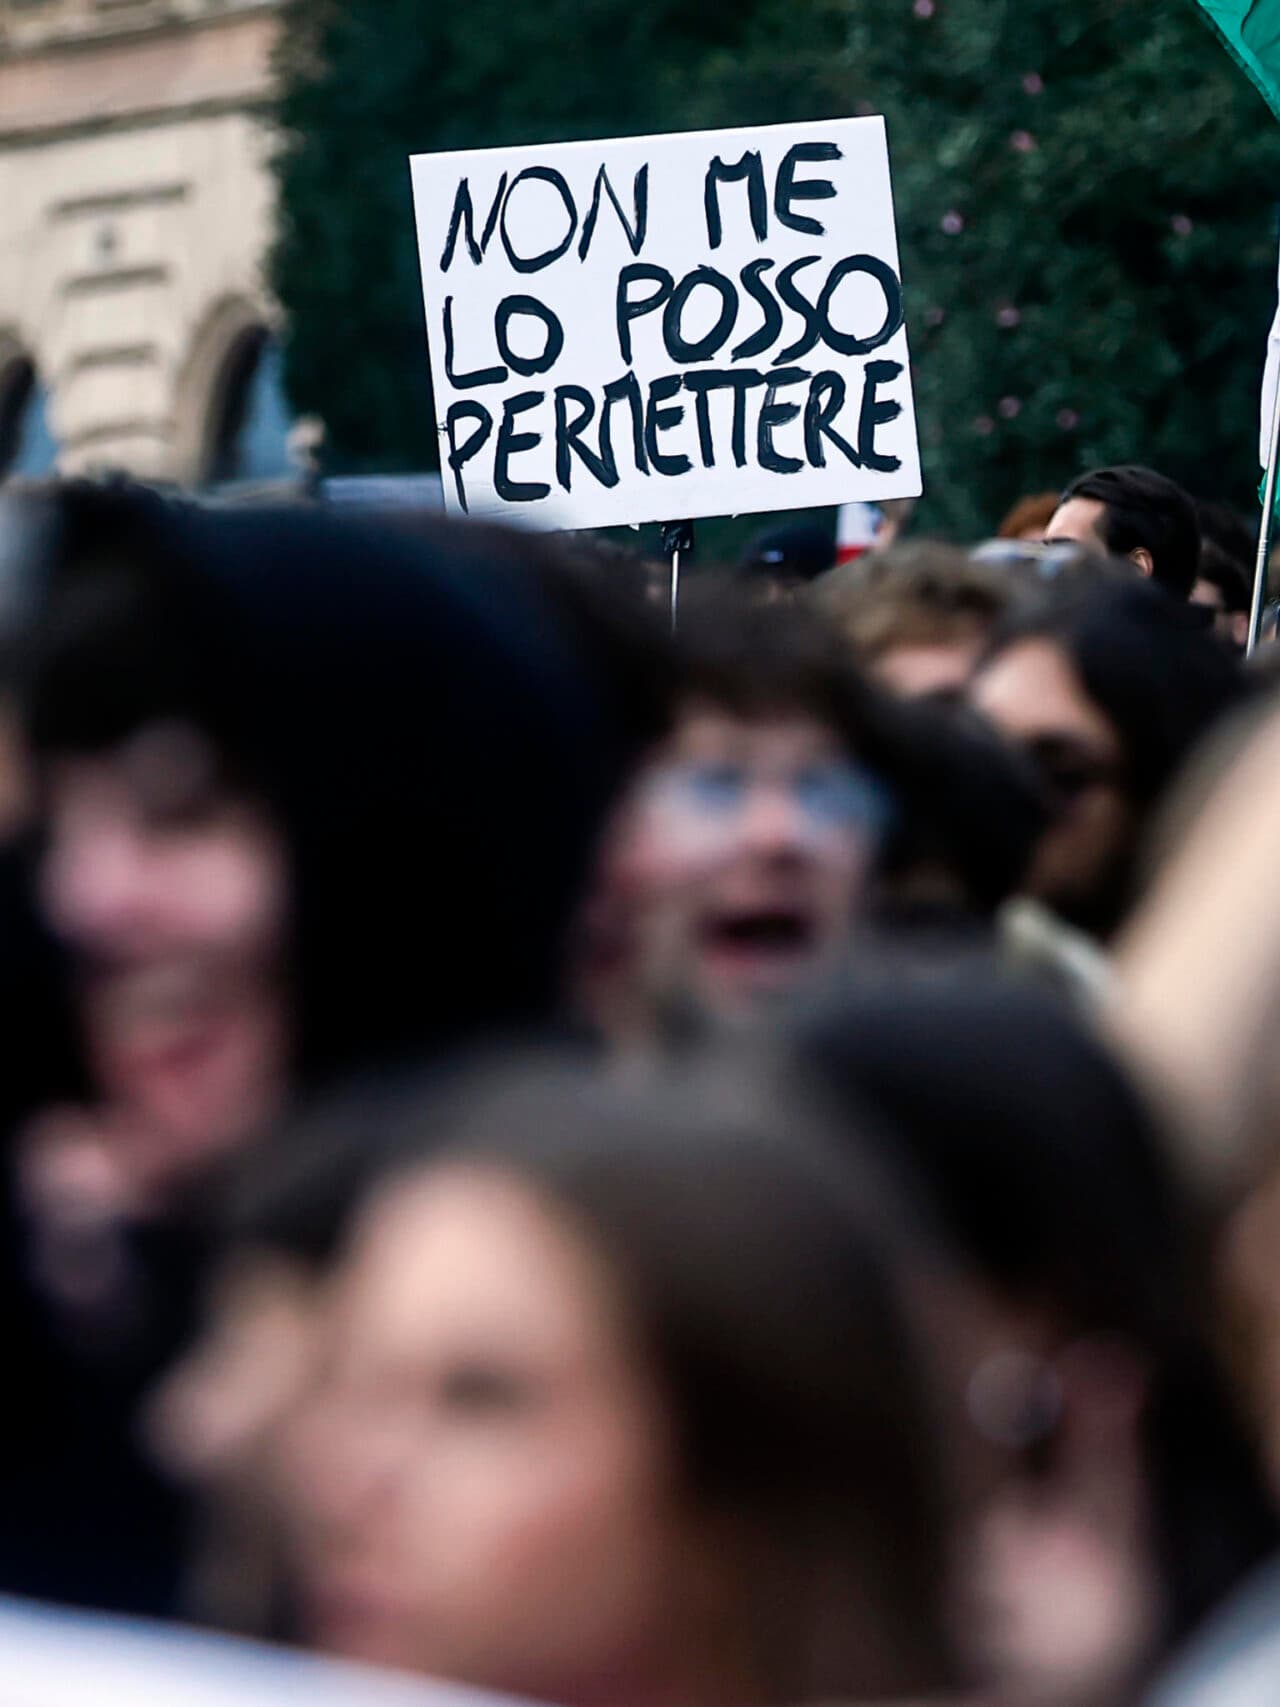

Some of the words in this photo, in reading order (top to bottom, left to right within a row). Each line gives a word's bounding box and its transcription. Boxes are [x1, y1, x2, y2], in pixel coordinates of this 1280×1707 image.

[440, 163, 649, 273] NON
[704, 143, 843, 249] ME
[443, 295, 565, 390] LO
[617, 253, 904, 366] POSSO
[448, 360, 904, 516] PERMETTERE
